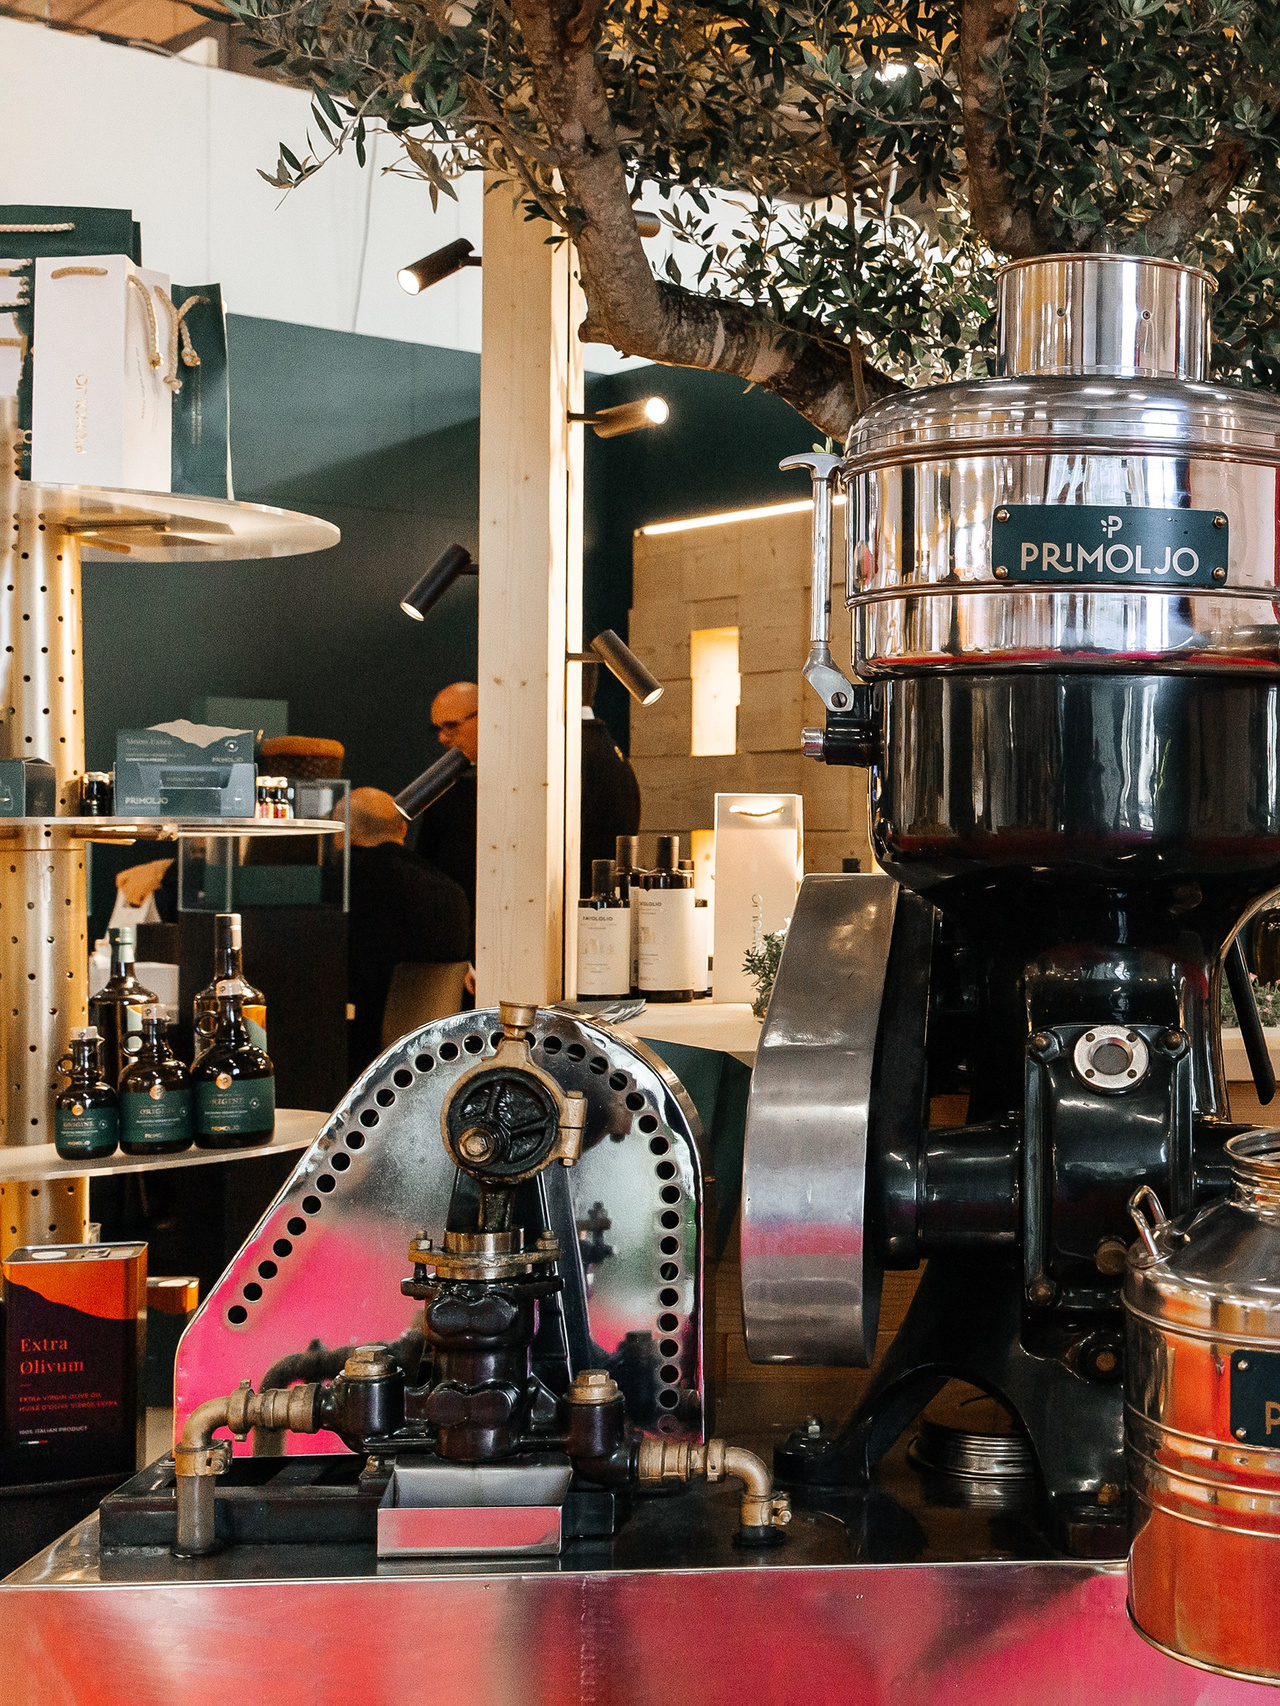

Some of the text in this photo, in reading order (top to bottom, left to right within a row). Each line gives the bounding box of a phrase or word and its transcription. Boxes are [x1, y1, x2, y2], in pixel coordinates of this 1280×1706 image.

[1020, 542, 1200, 577] PRIMOLJO
[124, 796, 169, 805] PRIMOLJO
[20, 1338, 68, 1353] Extra
